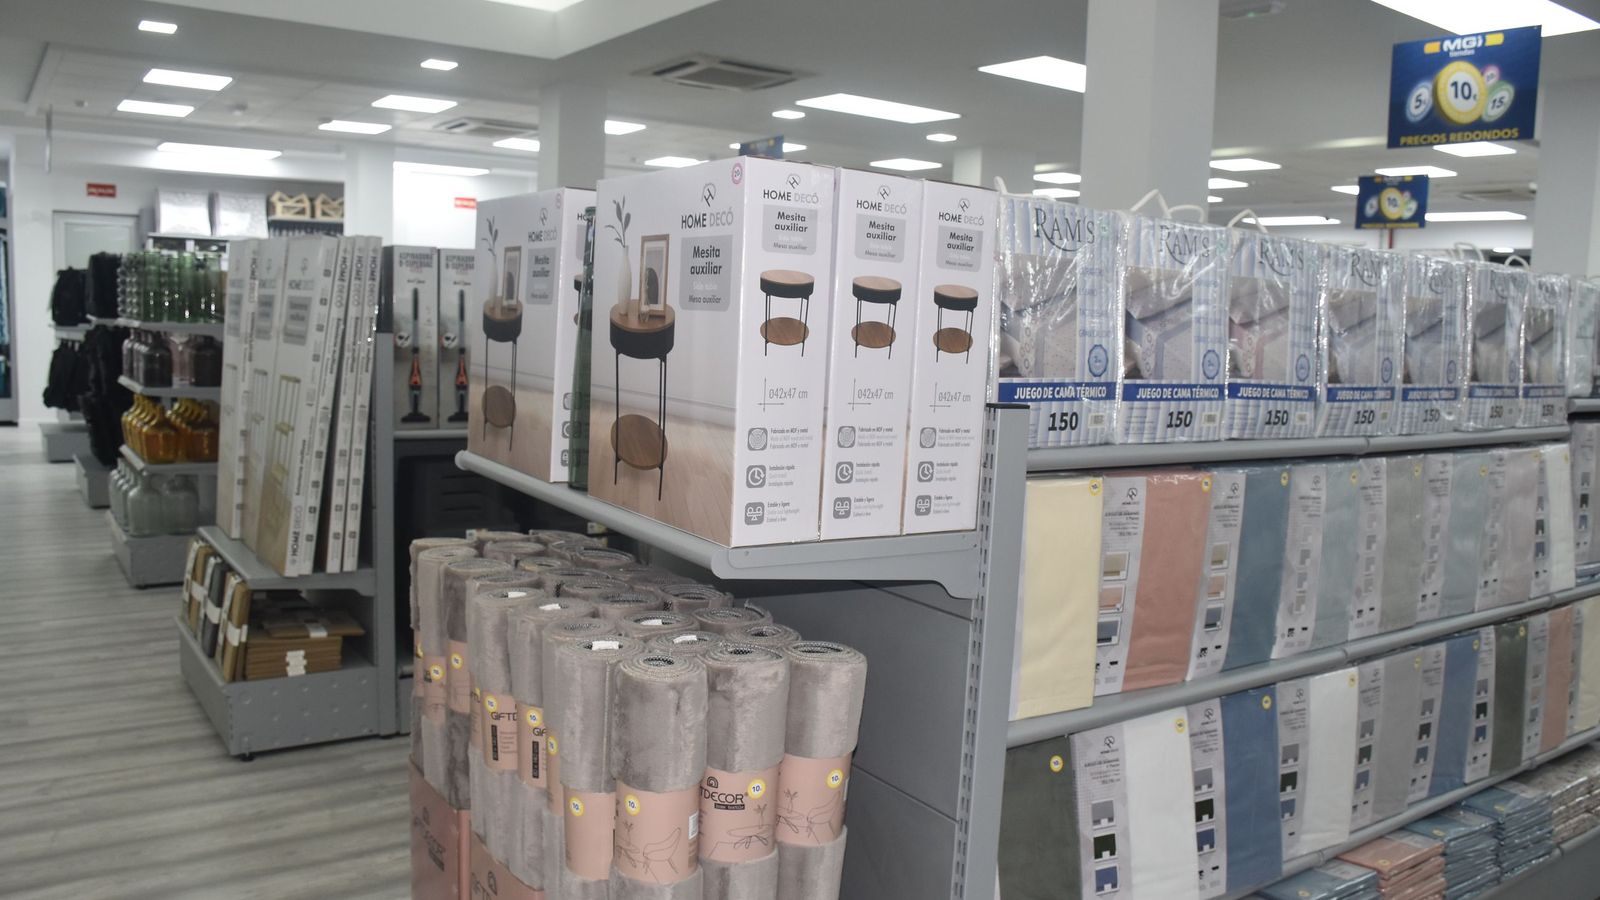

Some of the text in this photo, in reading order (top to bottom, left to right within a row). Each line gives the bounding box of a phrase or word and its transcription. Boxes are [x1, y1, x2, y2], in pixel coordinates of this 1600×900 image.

[1449, 49, 1475, 57] tiendas
[1400, 128, 1519, 145] PRECIOS REDONDOS
[763, 189, 819, 204] HOME DECÓ
[856, 199, 907, 215] HOME DECÓ
[681, 206, 734, 229] HOME DECÓ
[777, 211, 806, 222] Mesita
[938, 212, 985, 226] HOME DECÓ
[774, 222, 808, 233] auxiliar
[868, 221, 895, 232] Mesita
[528, 230, 543, 242] HOME
[866, 231, 896, 242] auxiliar
[949, 232, 973, 243] Mesita
[692, 245, 721, 259] Mesita
[946, 242, 974, 252] auxiliar
[339, 256, 347, 282] HOME
[368, 256, 377, 282] HOME
[690, 261, 722, 275] auxiliar
[797, 390, 808, 399] cm
[884, 391, 894, 399] cm
[962, 394, 971, 402] cm
[1014, 384, 1107, 400] JUEGO DE CAMA TÉRMICO
[1136, 385, 1219, 399] JUEGO DE CAMA TÉRMICO
[1237, 387, 1262, 397] JUEGO
[1262, 388, 1270, 398] DE
[1048, 411, 1079, 432] 150
[1166, 410, 1193, 429] 150
[1265, 410, 1289, 426] 150
[1354, 410, 1375, 425] 150
[1423, 409, 1440, 422] 150
[291, 531, 300, 557] HOME
